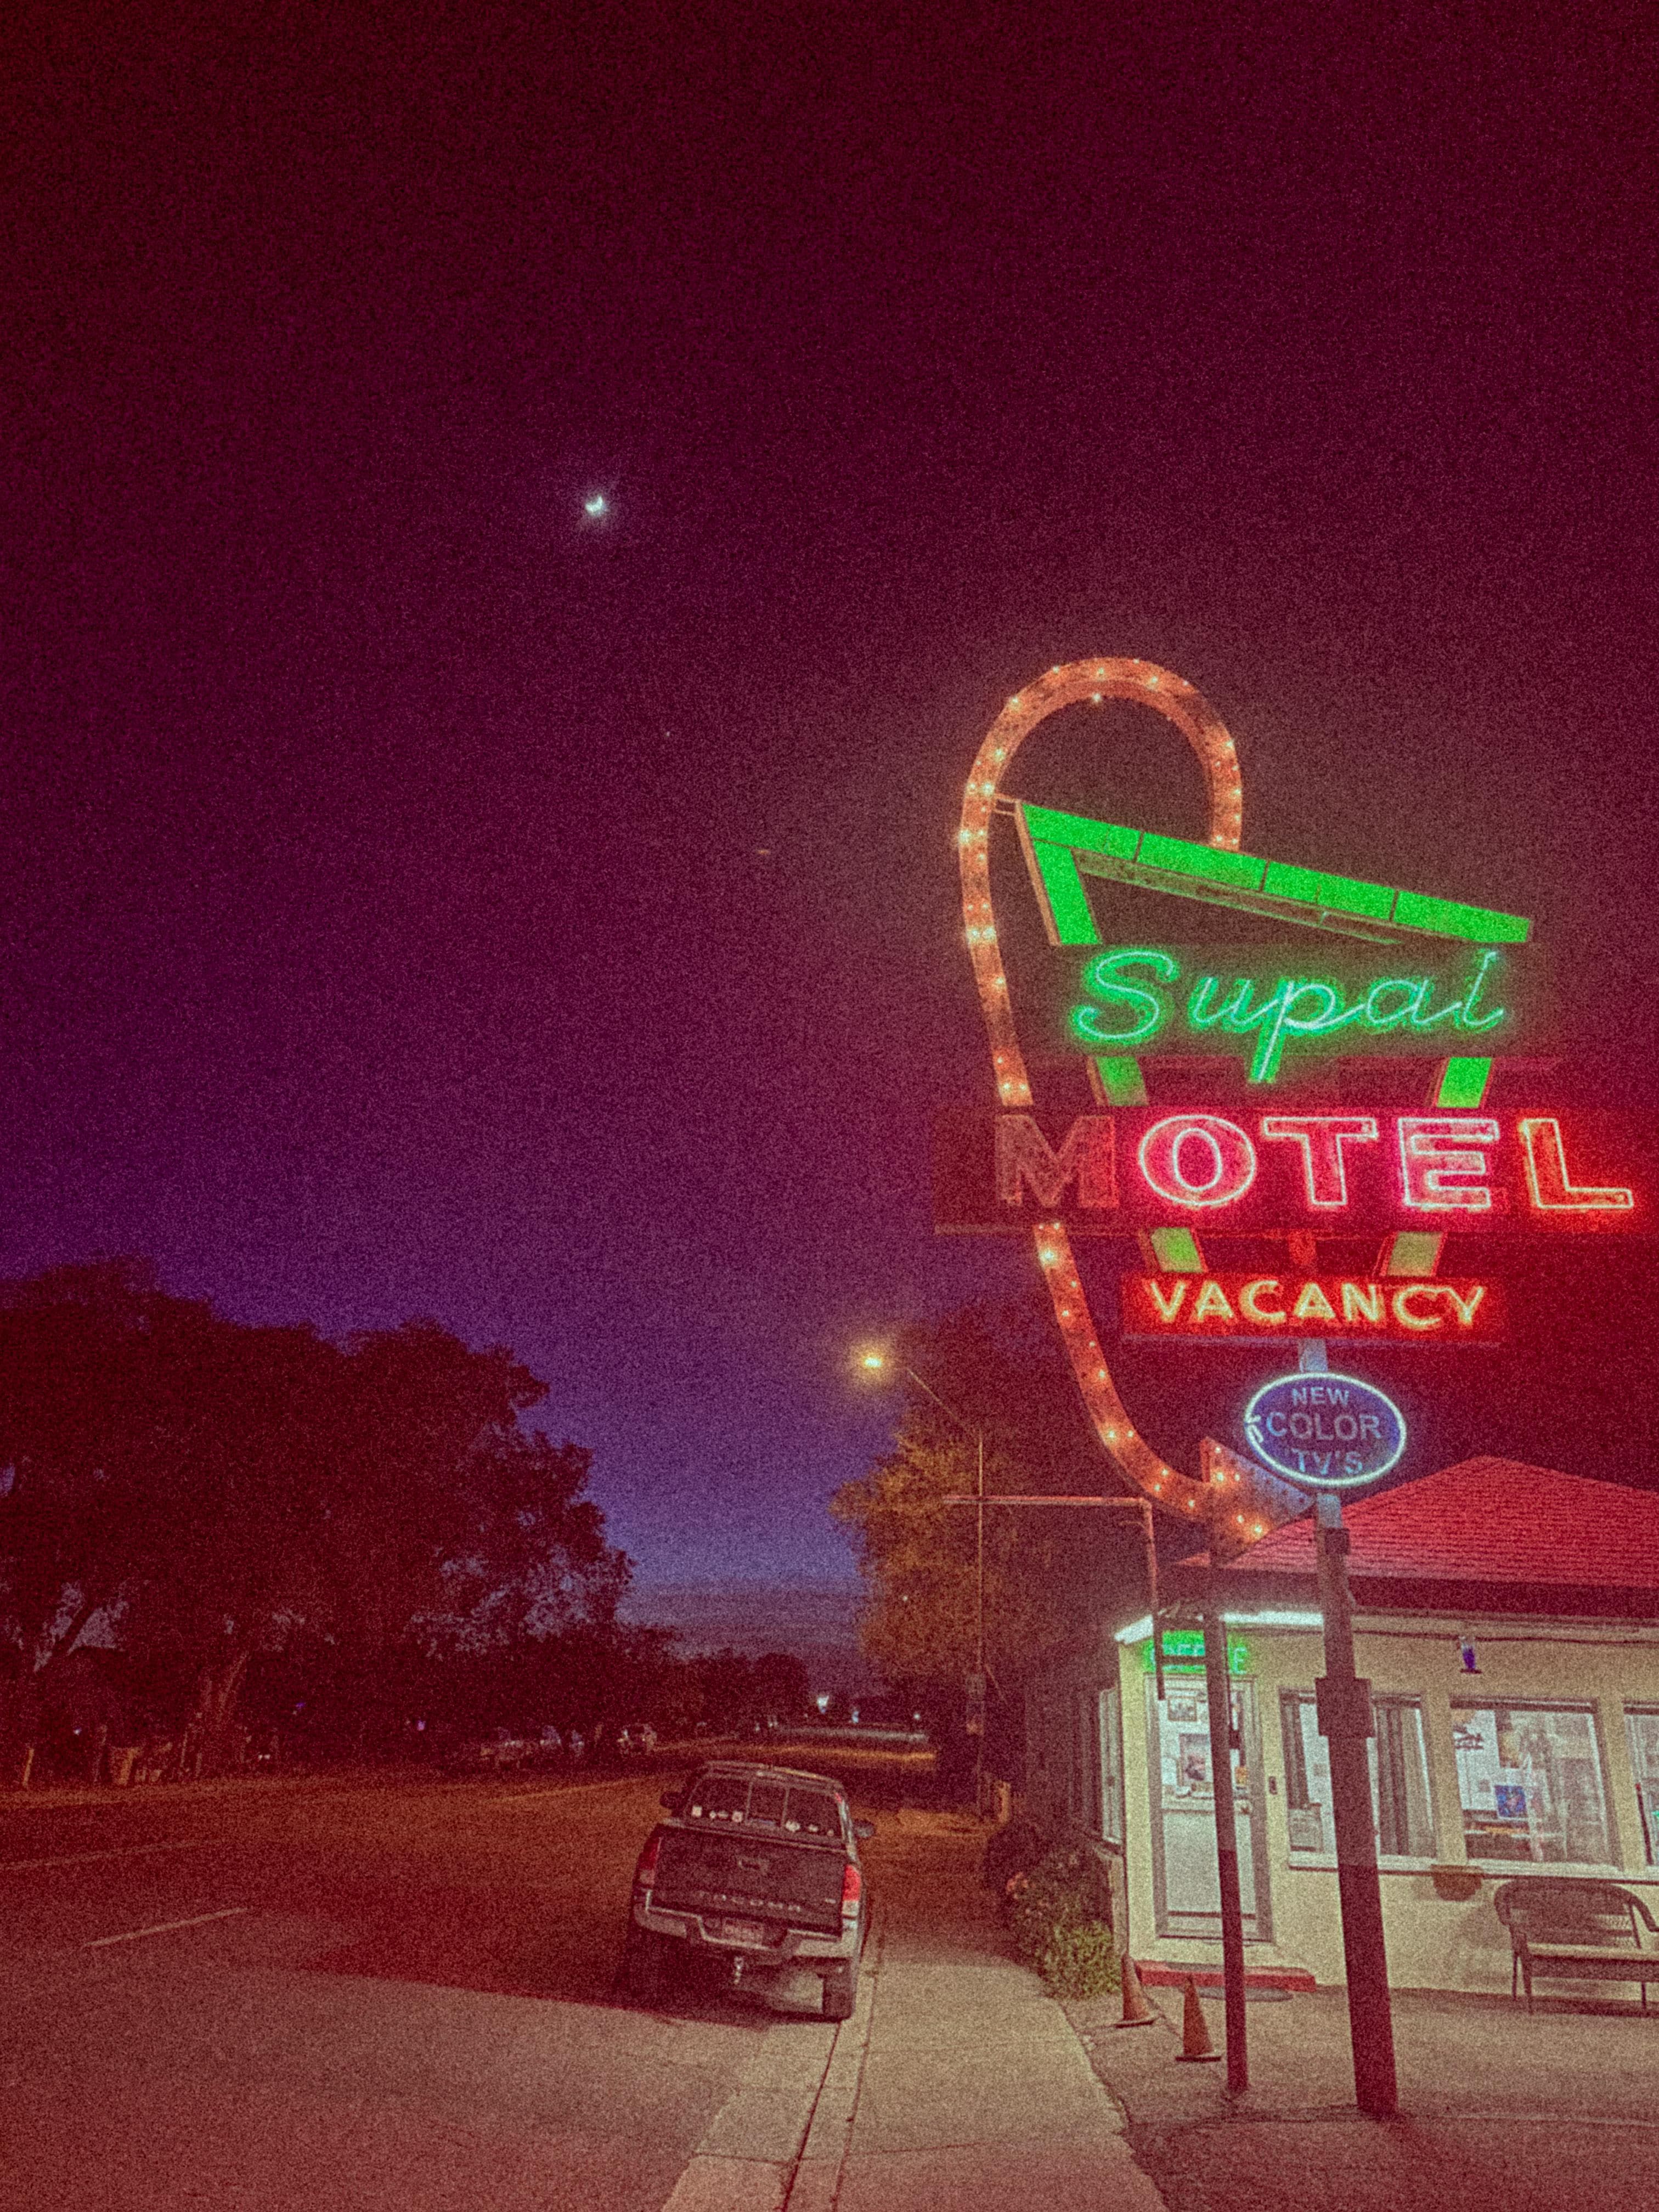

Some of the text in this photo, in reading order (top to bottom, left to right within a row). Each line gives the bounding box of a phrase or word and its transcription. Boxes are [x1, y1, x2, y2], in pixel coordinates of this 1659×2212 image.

[994, 1114, 1634, 1210] MOTEL
[1150, 1280, 1486, 1329] VACANCY
[1291, 1386, 1350, 1406] NEW
[1266, 1412, 1382, 1441] COLOR
